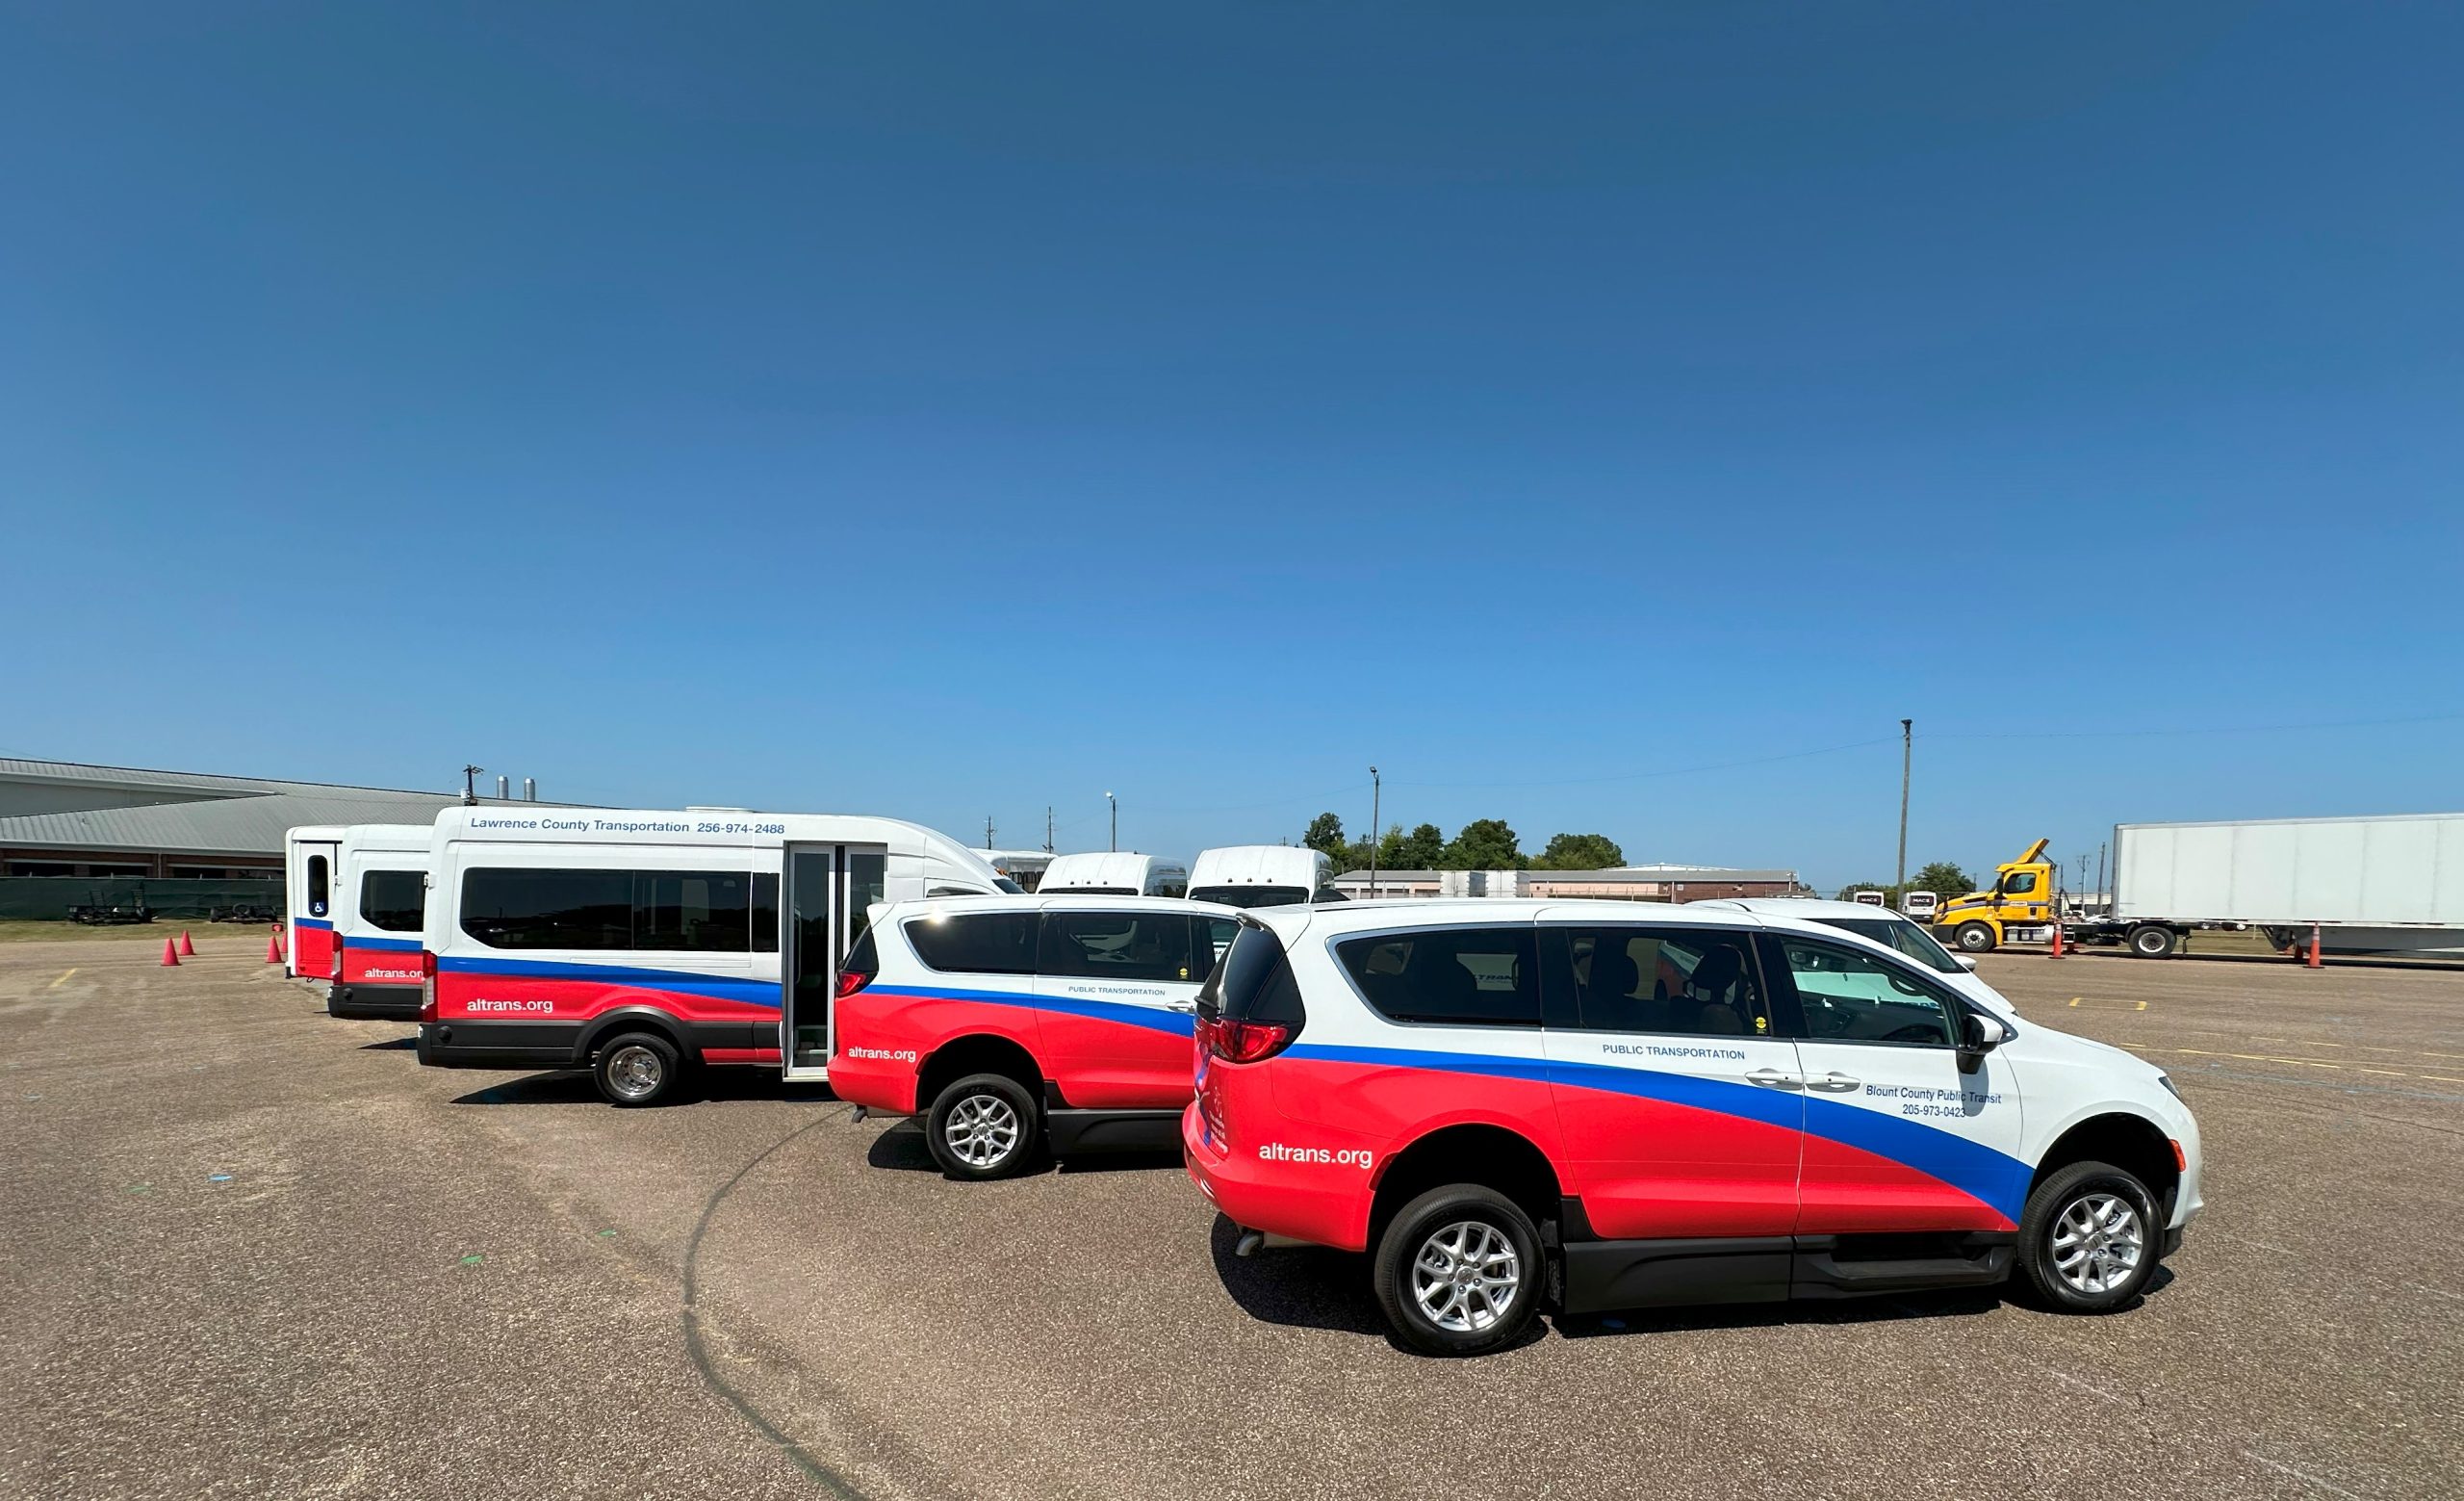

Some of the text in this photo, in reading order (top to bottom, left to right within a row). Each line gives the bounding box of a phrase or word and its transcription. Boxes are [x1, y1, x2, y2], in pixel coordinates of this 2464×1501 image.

[470, 816, 785, 834] Lawrence County Transportation 256-974-2488
[365, 968, 423, 978] altrans.or
[1098, 987, 1166, 996] TRANSPORTATION
[467, 997, 553, 1014] altrans.org
[848, 1046, 916, 1063] altrans.org
[1603, 1044, 1745, 1060] PUBLIC TRANSPORTATION
[1865, 1085, 2002, 1104] Blount County Public Transit
[1902, 1103, 1966, 1118] 205-973-0423
[1259, 1142, 1373, 1169] altrans.org
